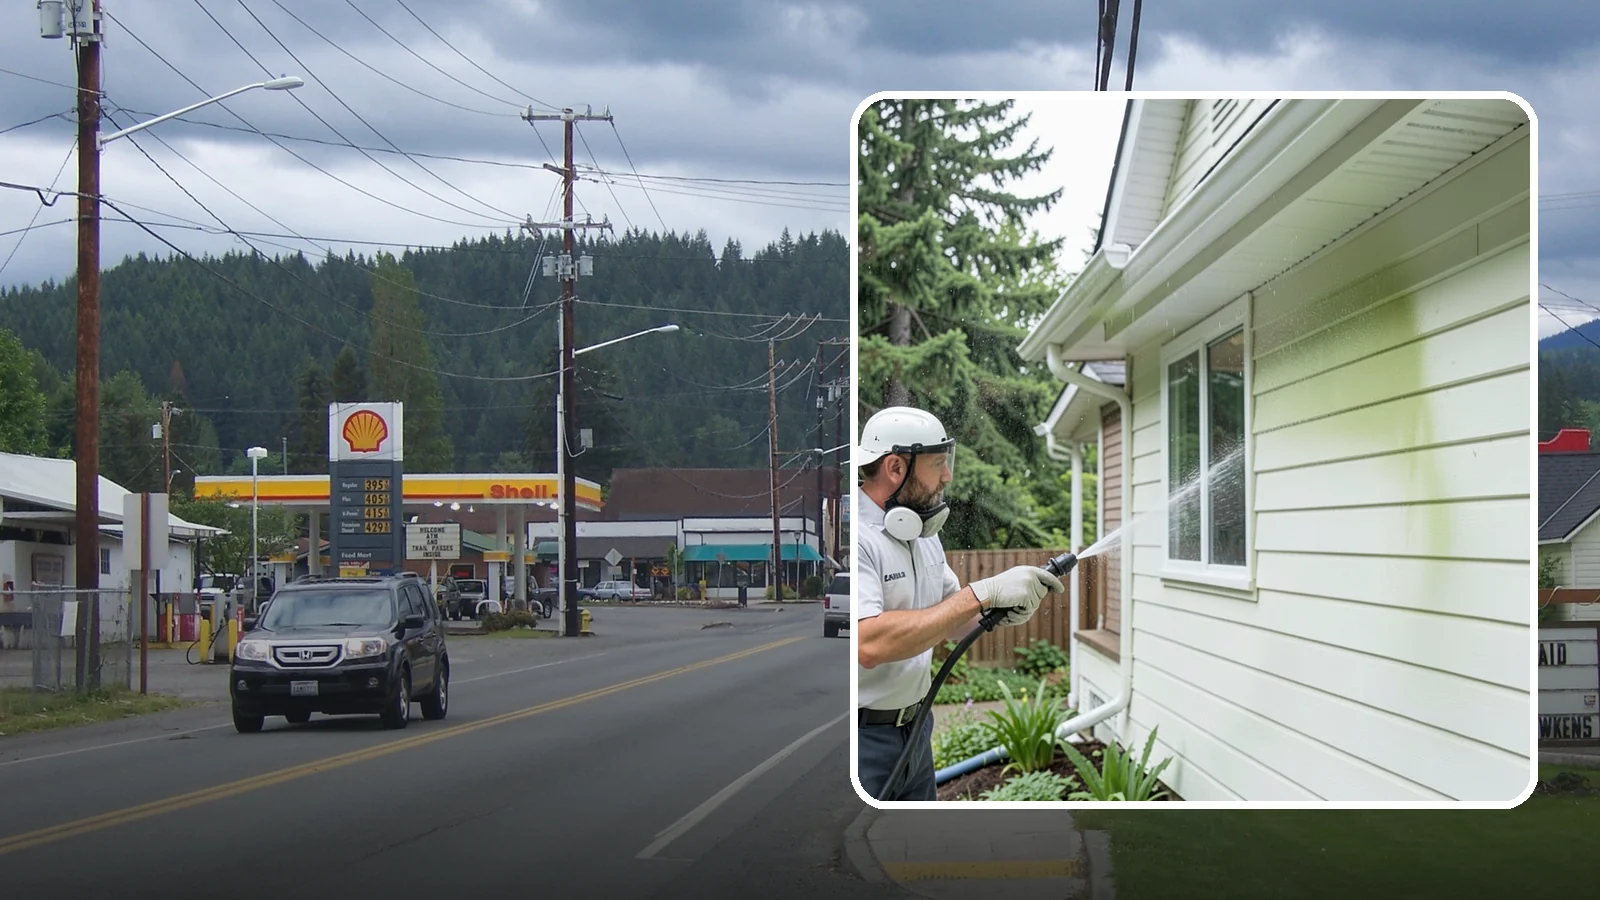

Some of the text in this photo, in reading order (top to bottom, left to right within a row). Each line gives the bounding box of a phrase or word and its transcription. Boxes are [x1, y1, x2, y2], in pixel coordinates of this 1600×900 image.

[366, 480, 383, 490] 395
[490, 484, 547, 499] Shell
[365, 494, 383, 504] 405
[365, 508, 383, 518] 415
[366, 522, 384, 532] 429
[1538, 642, 1567, 666] AID
